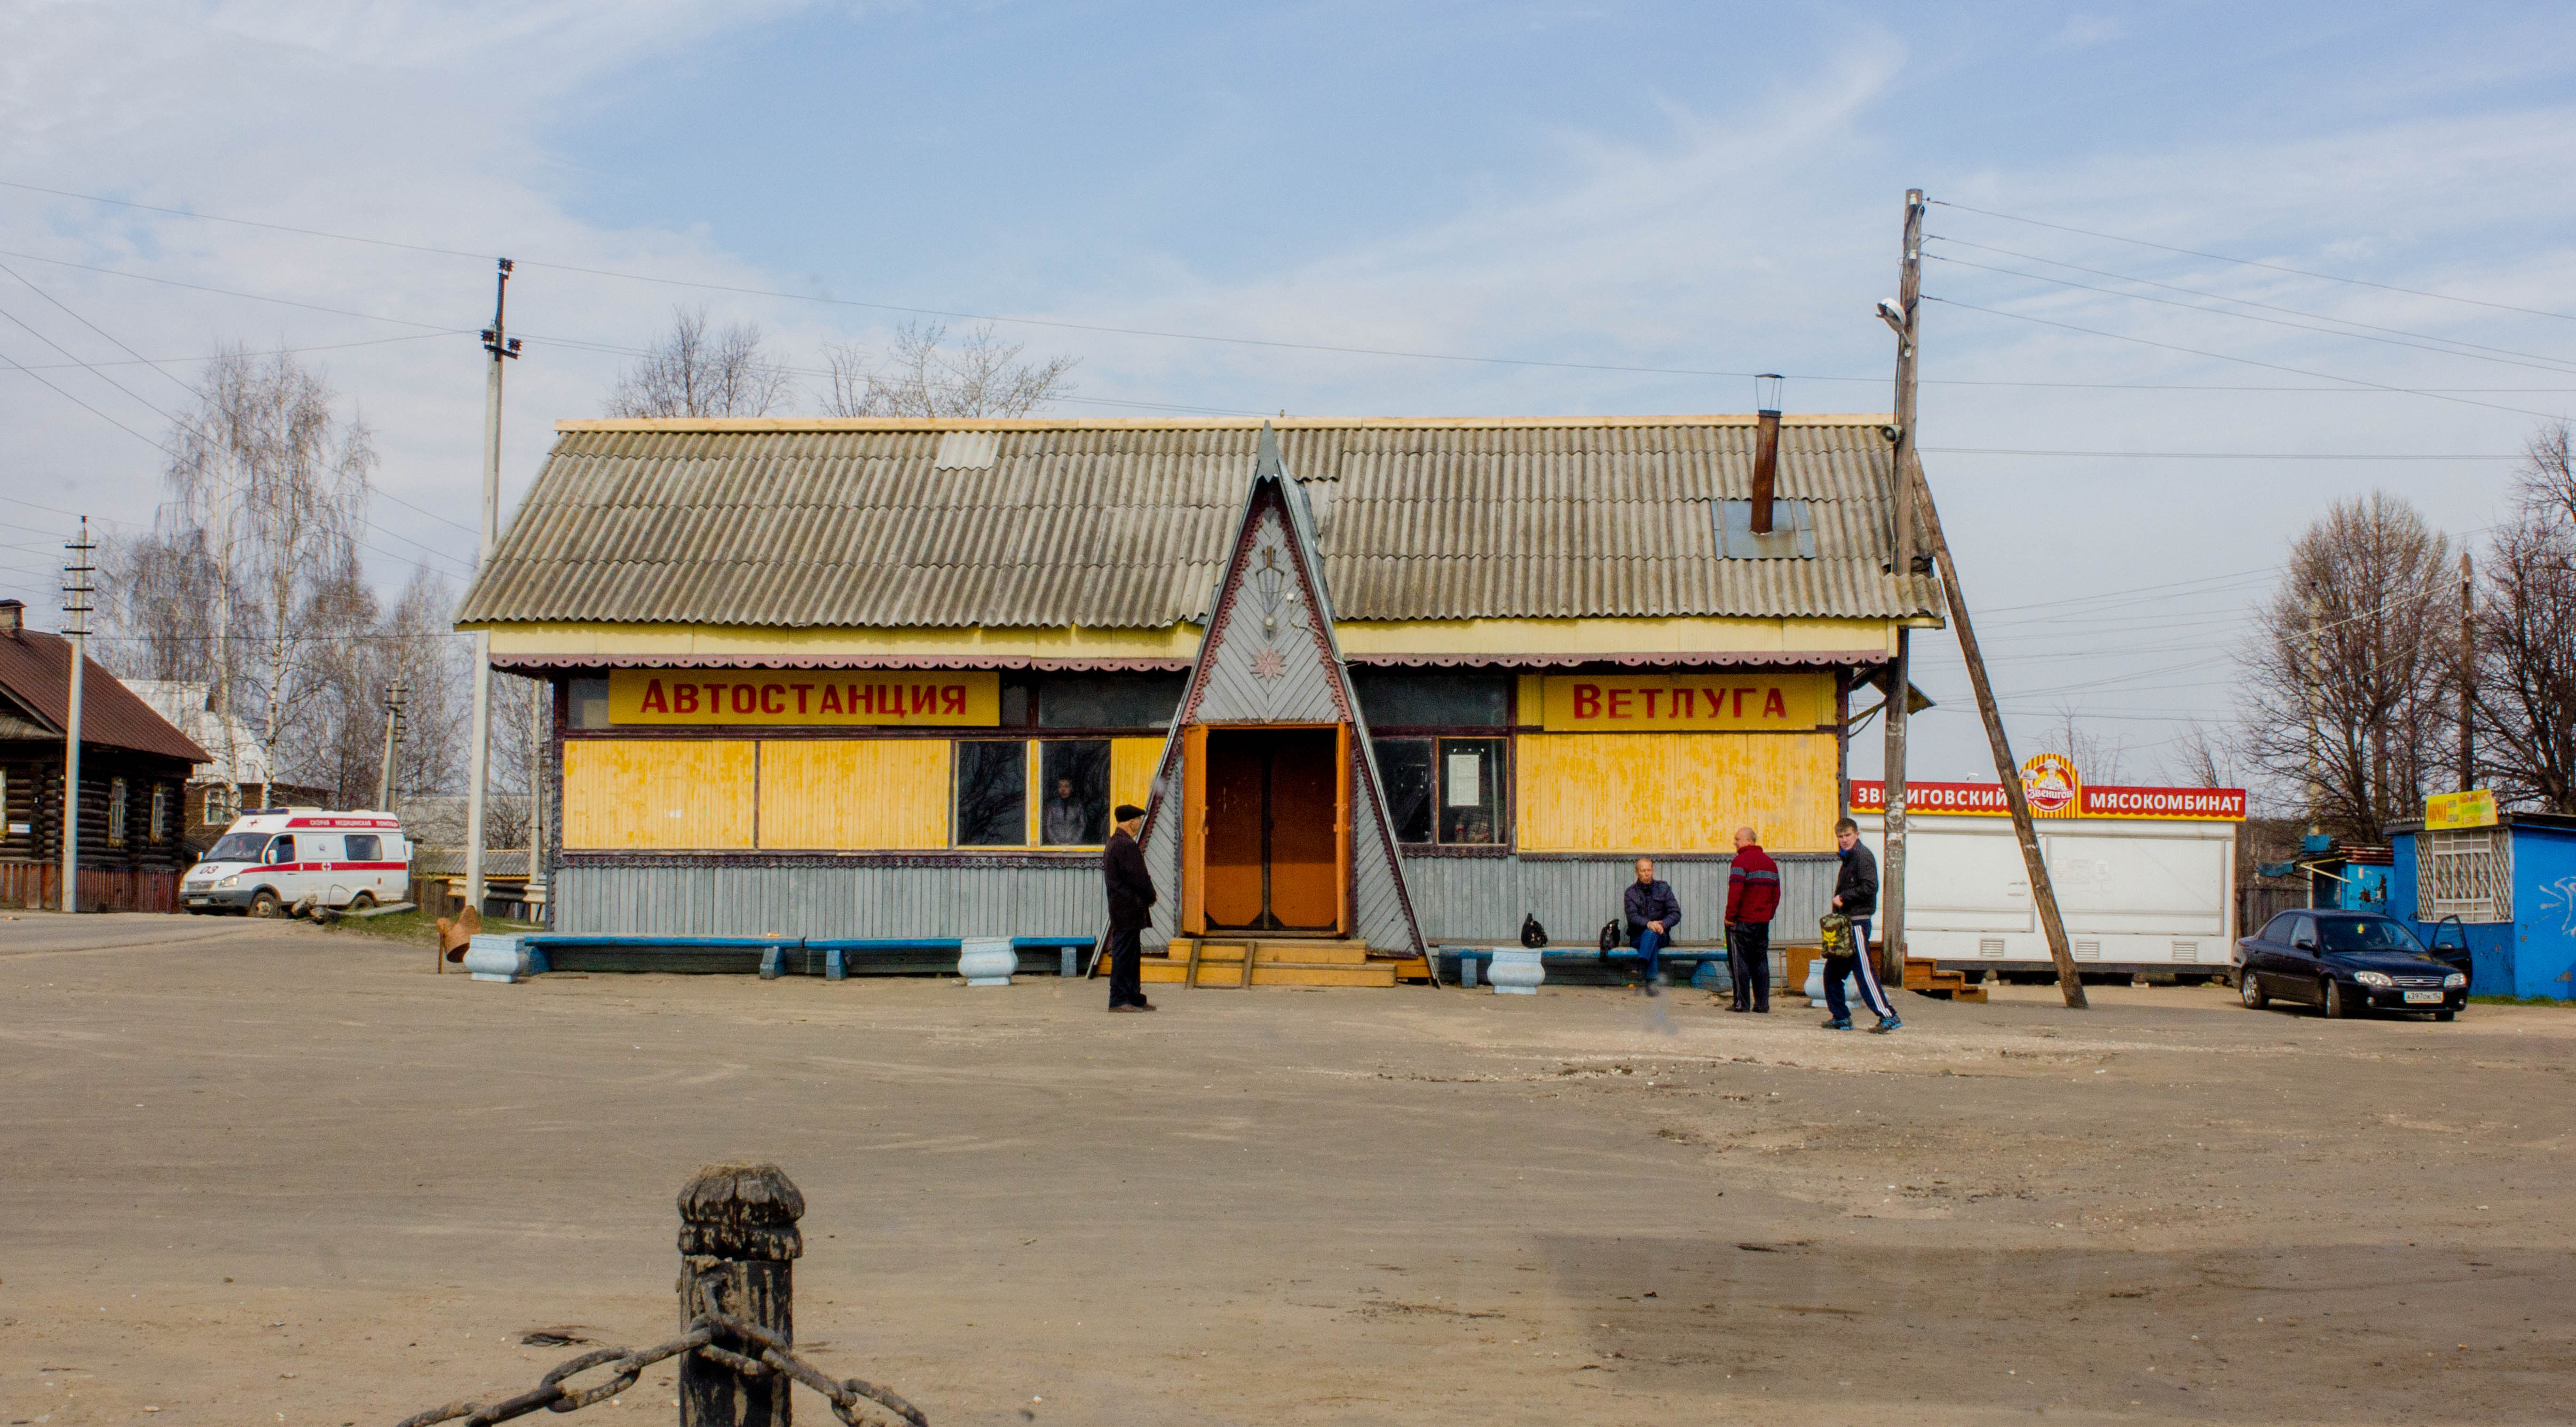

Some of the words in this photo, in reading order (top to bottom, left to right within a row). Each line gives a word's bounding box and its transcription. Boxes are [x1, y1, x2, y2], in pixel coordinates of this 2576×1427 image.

[641, 678, 967, 718] АВТОСТАНЦИЯ
[1573, 684, 1789, 720] ВЕТЛУГА
[1858, 787, 2008, 806] ЗВИГОВСКИЙ
[2090, 792, 2242, 812] МЯСОКОМБИНАТ
[199, 866, 219, 874] 03
